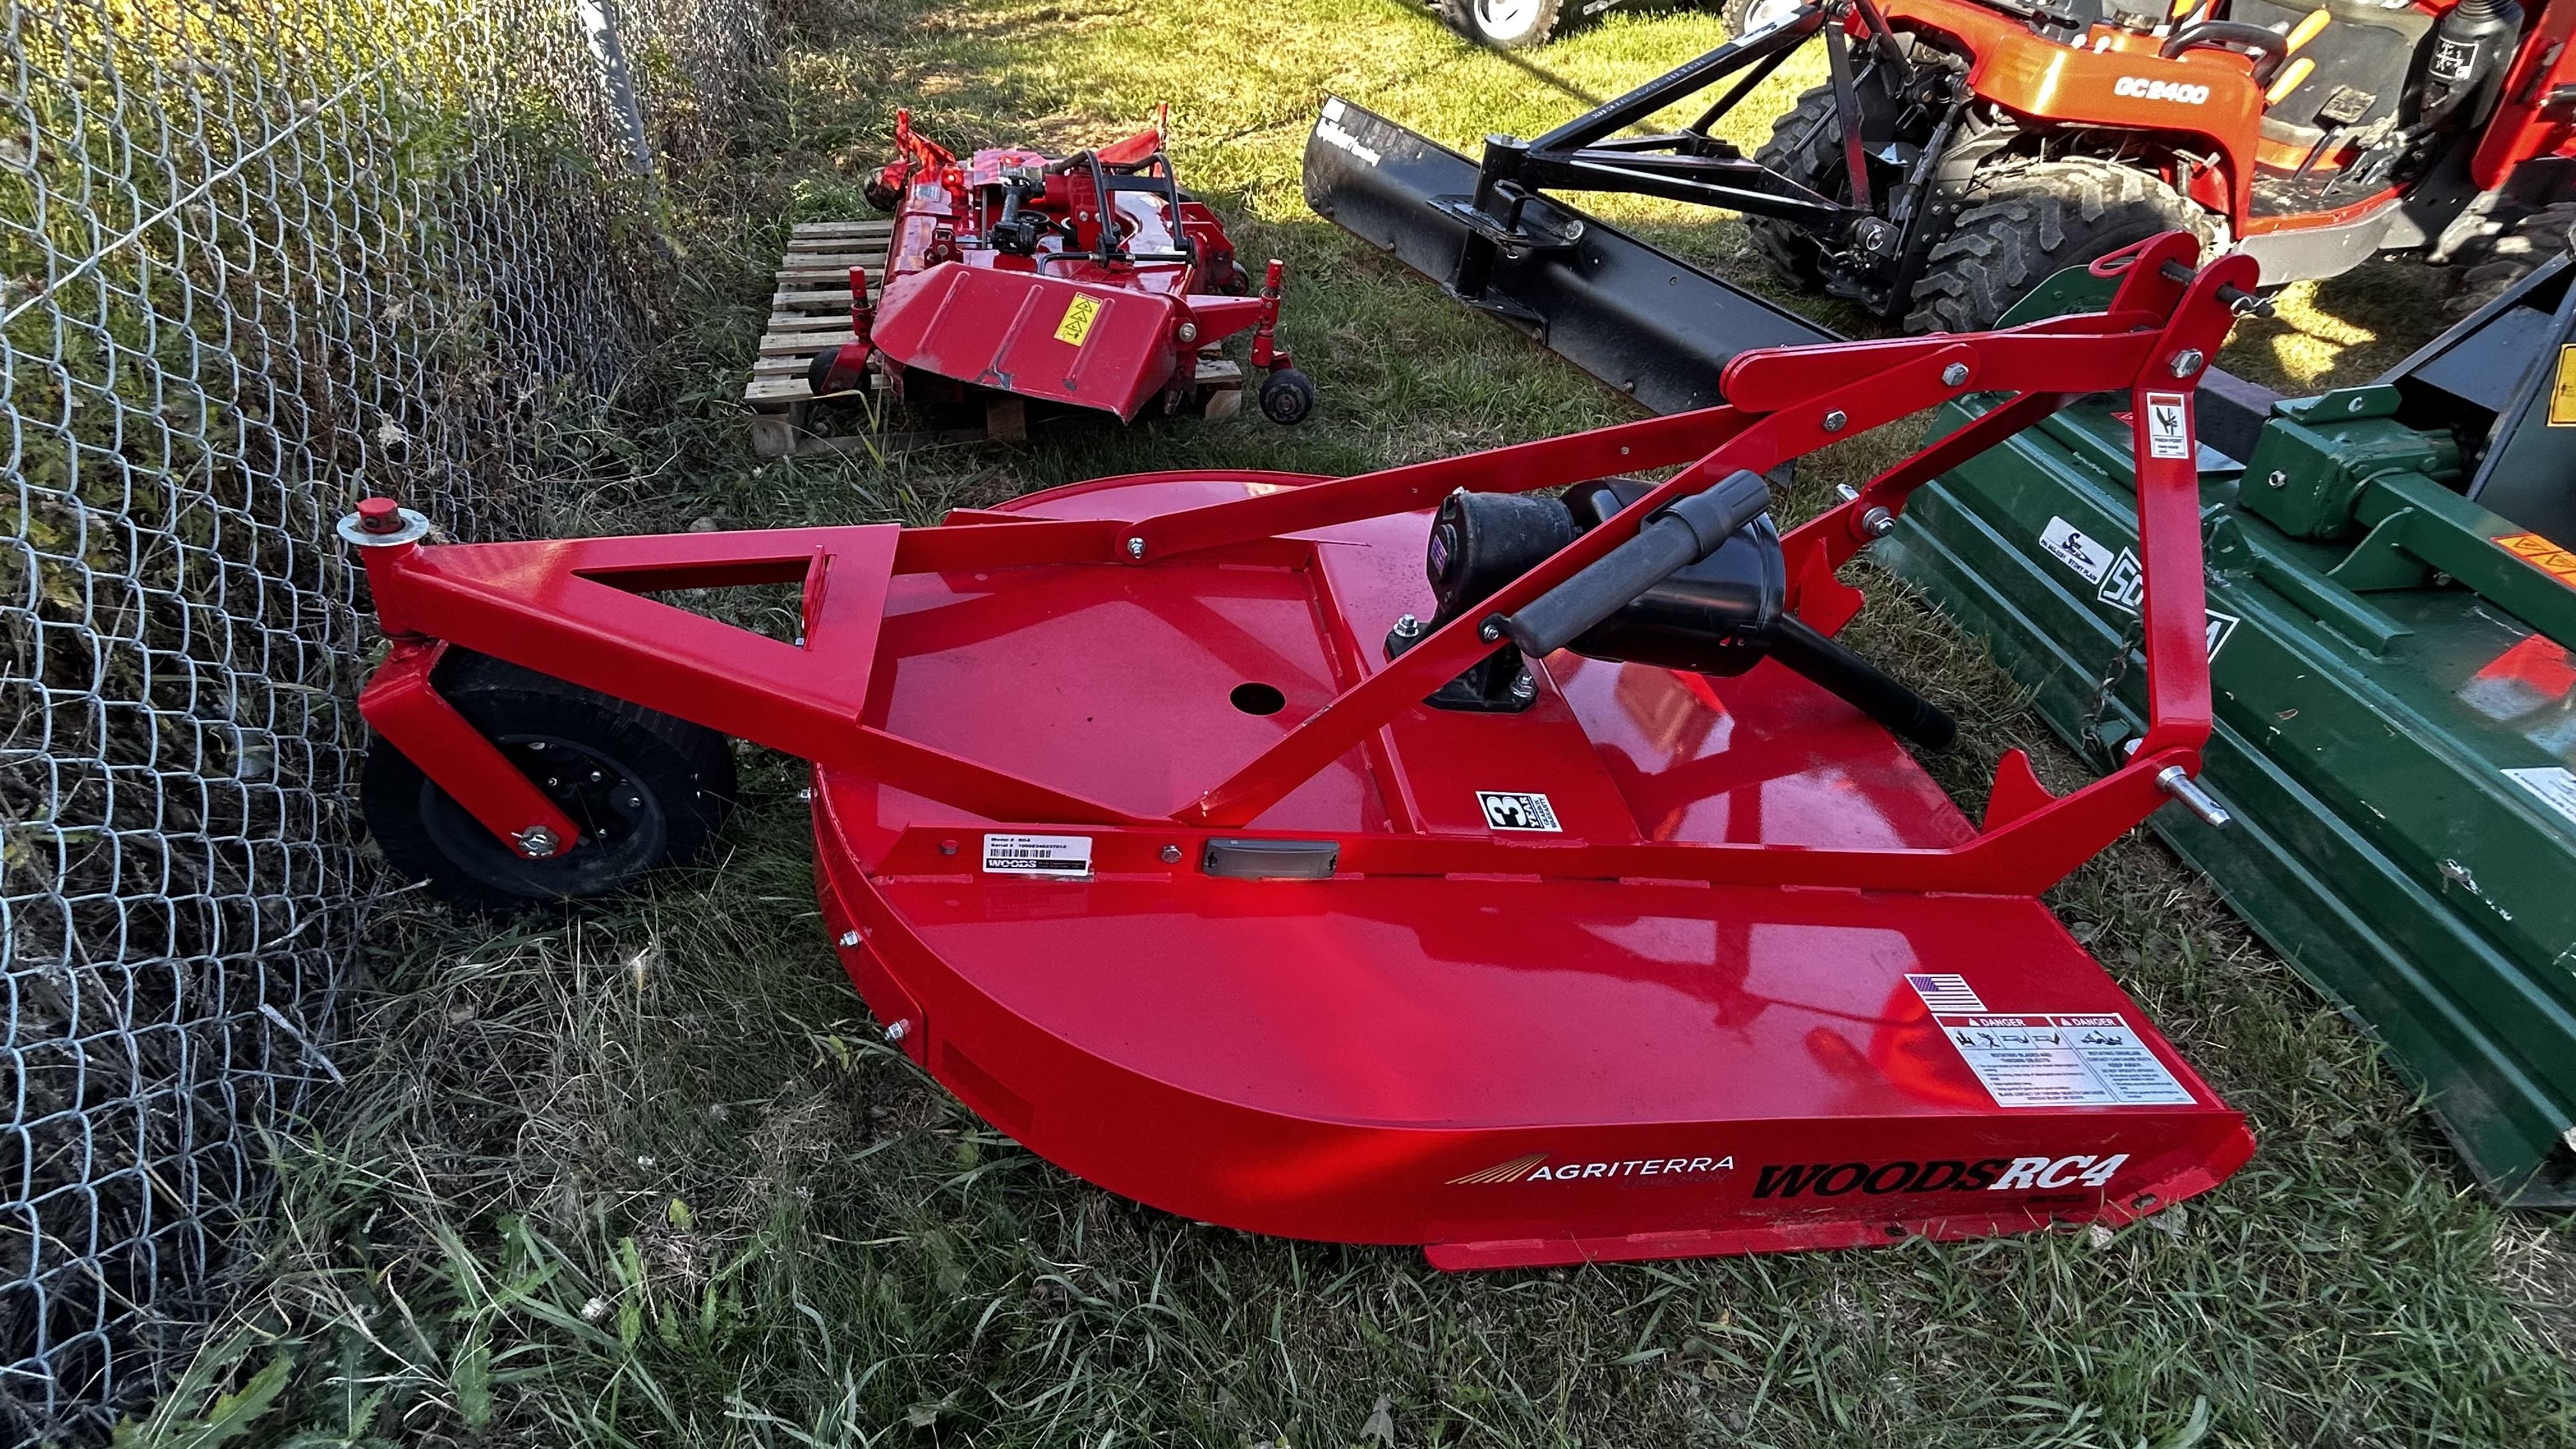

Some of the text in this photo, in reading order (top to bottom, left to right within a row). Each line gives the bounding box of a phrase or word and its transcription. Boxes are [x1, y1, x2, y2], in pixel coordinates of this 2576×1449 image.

[1487, 796, 1527, 826] 3
[1519, 796, 1540, 827] YEAR
[988, 859, 1037, 868] WOODS
[1979, 1018, 2027, 1027] DANGER
[2071, 1017, 2117, 1026] DANGER
[1526, 1155, 1735, 1181] AGRITERRA
